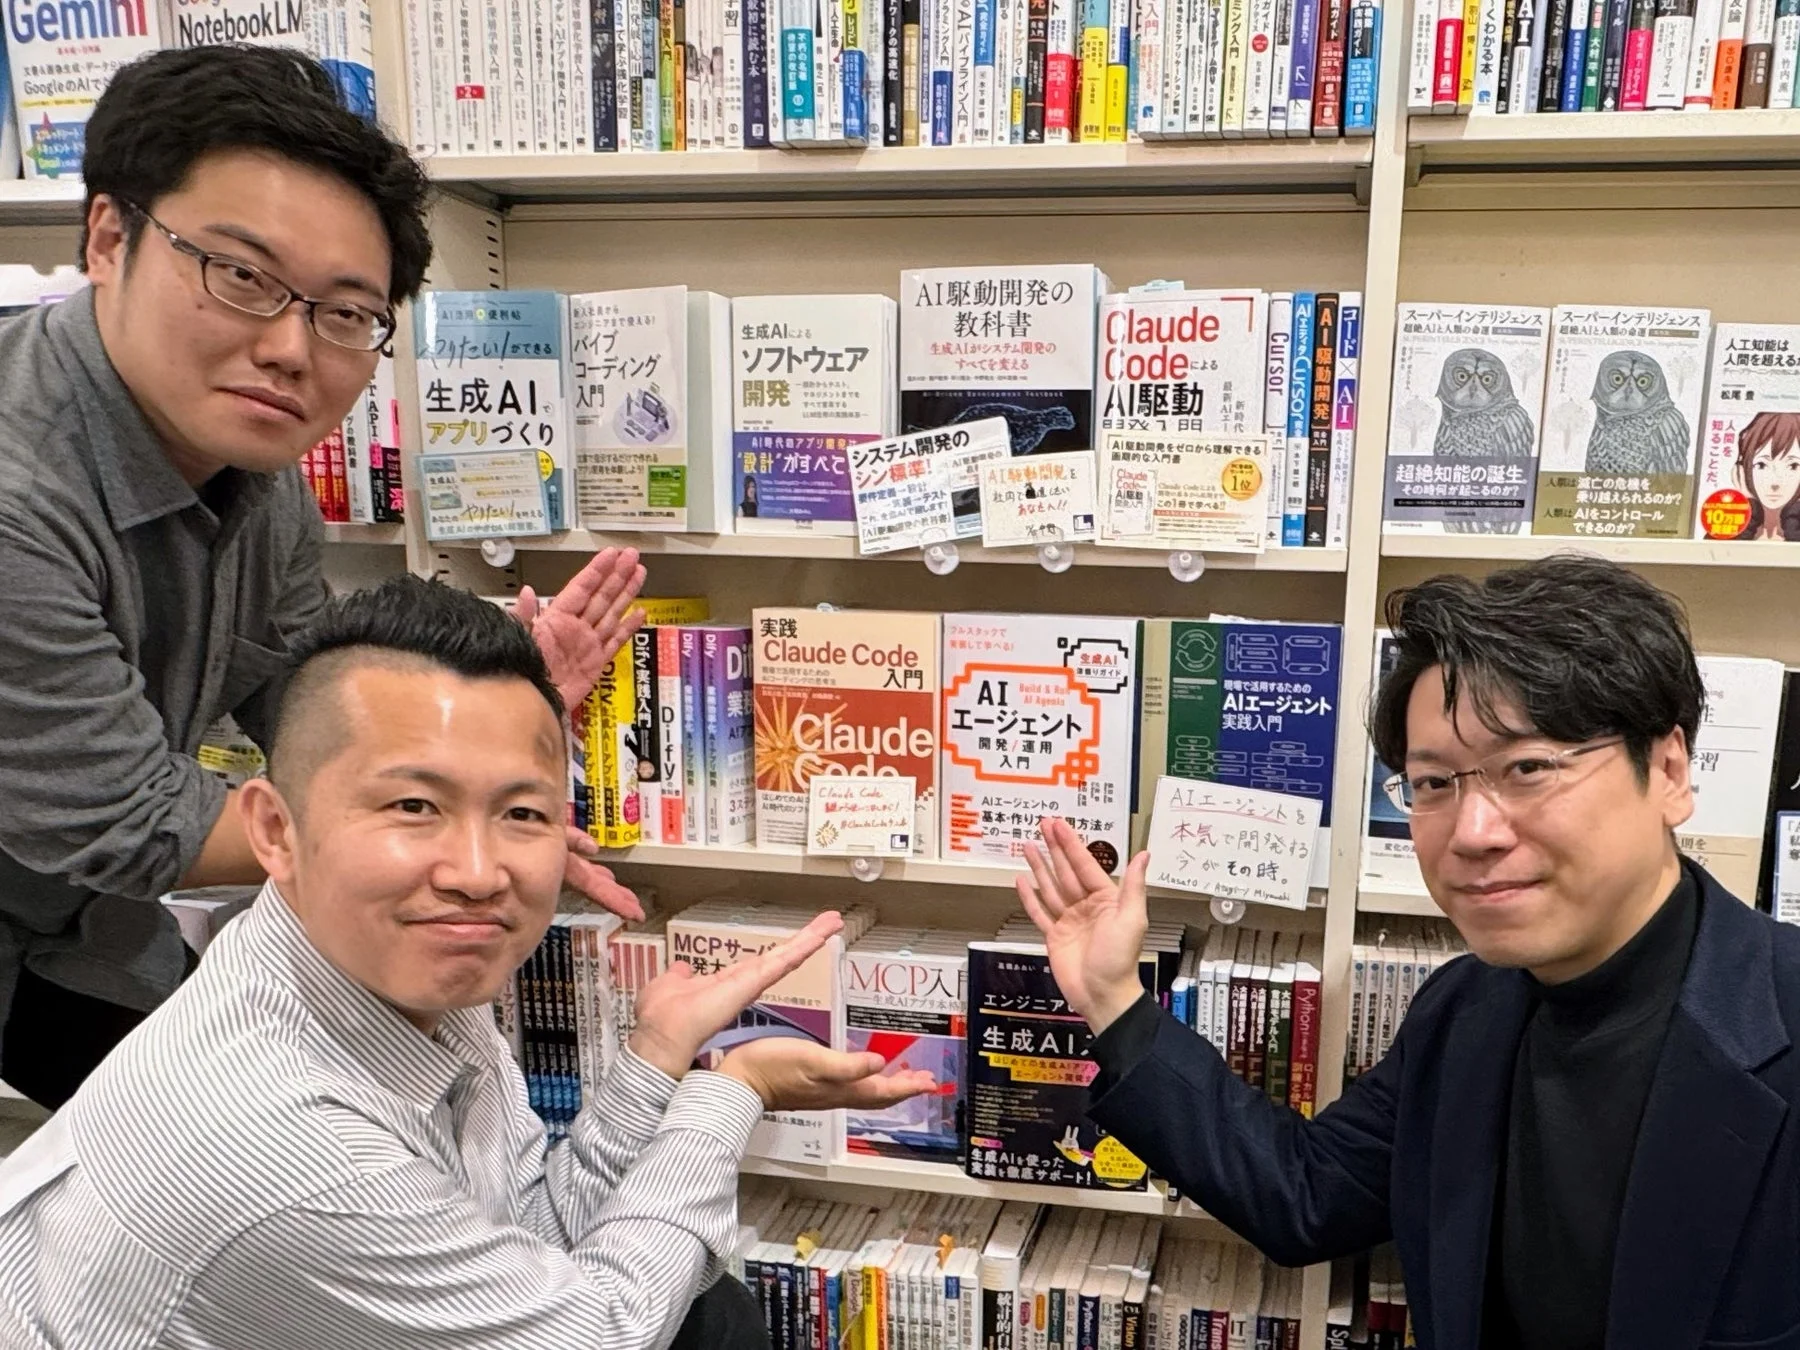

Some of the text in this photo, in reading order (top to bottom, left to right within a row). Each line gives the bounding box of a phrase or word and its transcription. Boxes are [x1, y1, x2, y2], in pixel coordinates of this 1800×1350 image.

[9, 0, 148, 43] Gemini
[179, 0, 304, 47] NotebookLM
[1144, 4, 1159, 36] 入門
[915, 278, 1074, 307] AI駆動開発の
[954, 309, 1032, 338] 教科書
[1106, 306, 1219, 344] Claude
[1403, 323, 1490, 336] 超絶AIと人類の命運
[1405, 309, 1543, 326] スーパーインテリジェンス
[1561, 311, 1700, 328] スーパーインテリジェンス
[574, 329, 619, 355] バイブ
[742, 323, 812, 340] 生成AIによる
[1559, 324, 1647, 338] 超絶AIと人類の命運
[930, 341, 1057, 356] 生成AIがシステム開発の
[1725, 338, 1789, 352] 人工知能は
[576, 354, 662, 380] コーディング
[742, 346, 869, 373] ソフトウェア
[955, 358, 1030, 372] すべてを変える
[1269, 332, 1289, 396] Cursor
[1313, 307, 1333, 420] AI駆動開発
[576, 384, 605, 408] 入門
[742, 380, 790, 407] 開発
[1103, 382, 1204, 417] AI駆動
[368, 400, 379, 438] API
[426, 419, 554, 447] アプリづくり
[1722, 419, 1736, 458] 人間を
[852, 430, 970, 469] システム開発の
[1111, 452, 1181, 464] 画期的な入門書
[1112, 440, 1262, 455] AI駆動開発をゼロから理解できる
[1705, 419, 1724, 489] 知ることだ。
[1117, 468, 1148, 481] Claude
[1231, 474, 1251, 491] 1位
[1395, 464, 1528, 485] 超絶知能の誕生。
[1577, 476, 1651, 491] 滅亡の危機を
[1401, 483, 1520, 497] その時何が起こるのか?
[1575, 489, 1682, 506] 乗り越えられるのか?
[1573, 508, 1665, 522] AIをコントロール
[1573, 521, 1636, 535] できるのか?
[760, 617, 798, 639] 実践
[950, 626, 1008, 637] フルスタックで
[764, 639, 919, 668] Claude Code
[1079, 653, 1117, 665] 生成AI
[883, 668, 924, 690] 入門
[1019, 682, 1041, 693] Build
[1223, 679, 1312, 693] 現場で活用するための
[977, 680, 1008, 707] AI
[1222, 693, 1332, 716] AIエージェント
[793, 712, 934, 758] Claude
[952, 708, 1082, 740] エージェント
[1221, 714, 1283, 733] 実践入門
[661, 706, 676, 782] Dify
[1000, 754, 1030, 769] 入門
[981, 796, 1059, 811] AIエージェントの
[1170, 787, 1306, 826] AIエージェントを
[1171, 818, 1309, 859] 本気で開発する
[1176, 849, 1289, 885] 今がその時。
[1299, 987, 1316, 1032] Python
[971, 1148, 1065, 1169] 生成AIを使った
[971, 1162, 1092, 1186] 実装を徹底サポート!
[1125, 1316, 1138, 1348] Vision
